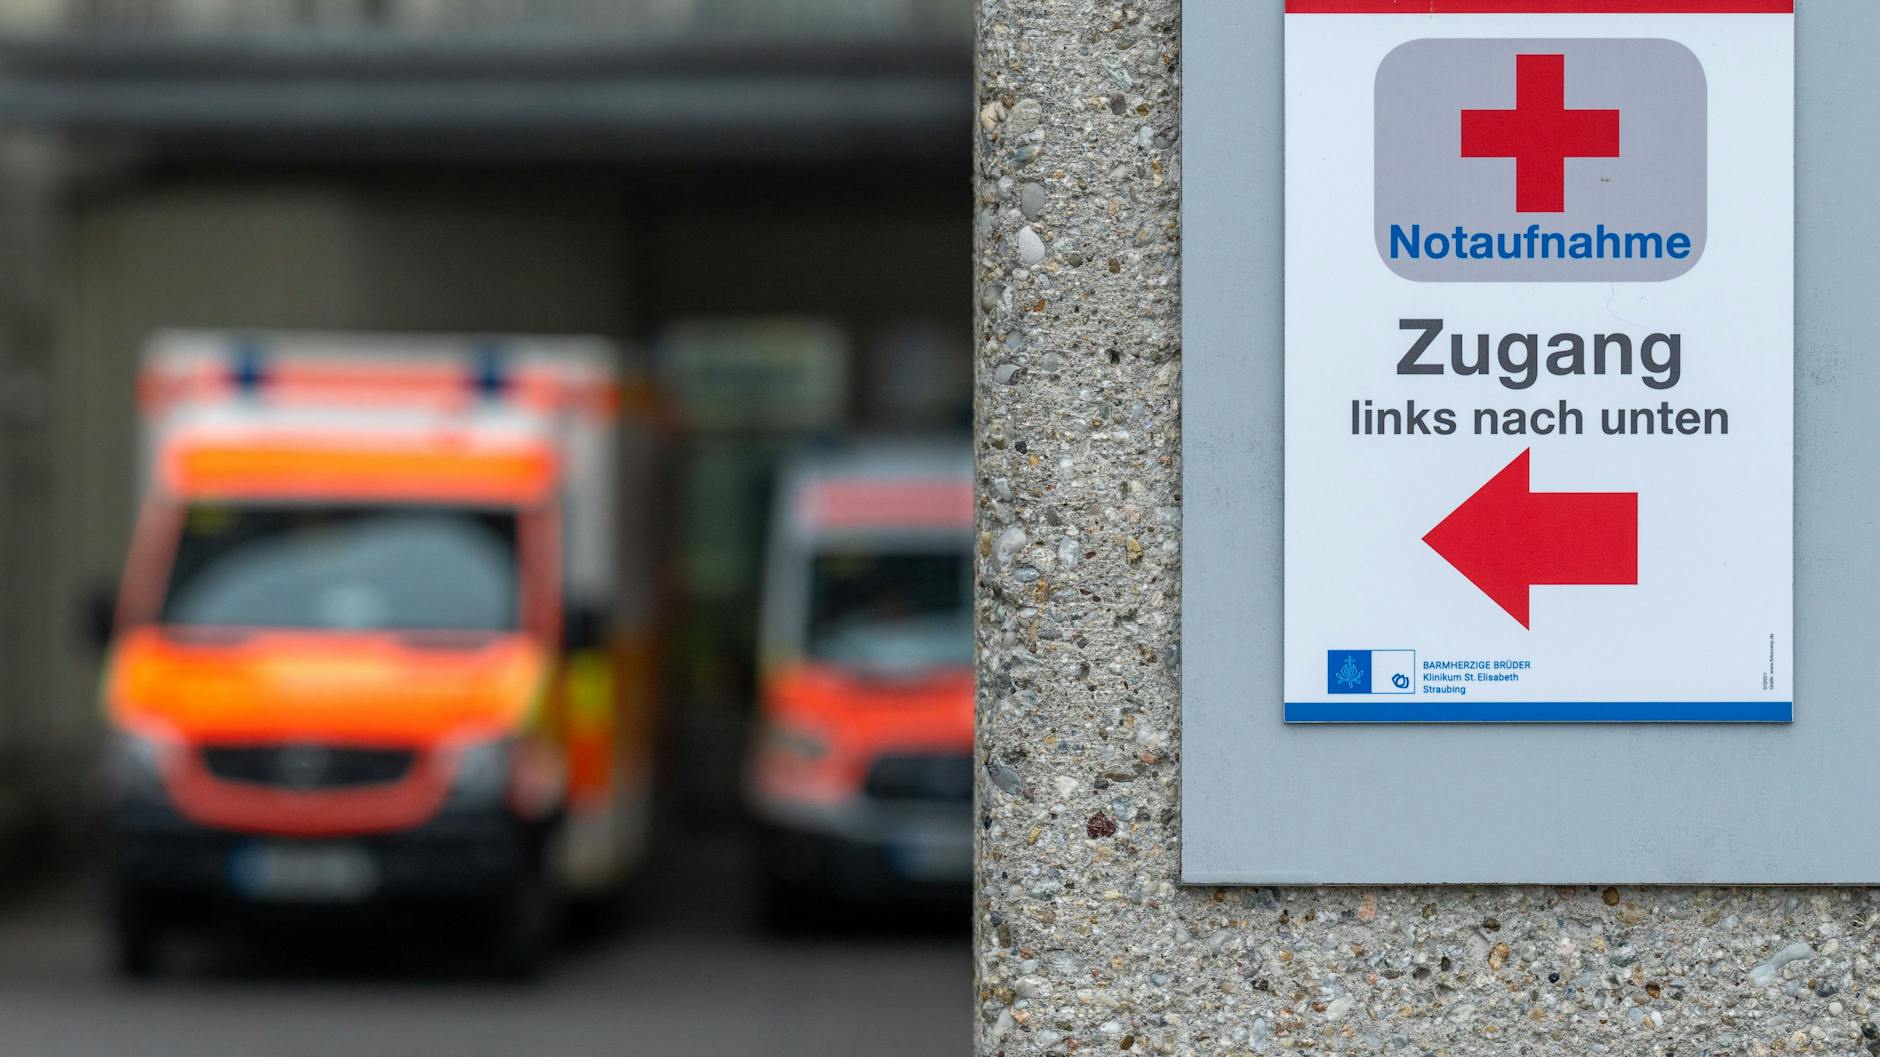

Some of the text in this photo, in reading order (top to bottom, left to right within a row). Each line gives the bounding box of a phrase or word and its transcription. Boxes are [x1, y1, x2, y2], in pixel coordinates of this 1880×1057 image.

[1391, 224, 1690, 260] Notaufnahme
[1397, 319, 1681, 390] Zugang
[1352, 400, 1728, 435] links nach unten
[1423, 659, 1531, 670] BARMHERZIGE BRÜDER
[1423, 673, 1519, 682] Klinikum St. Elisabeth
[1423, 685, 1467, 696] Straubing
